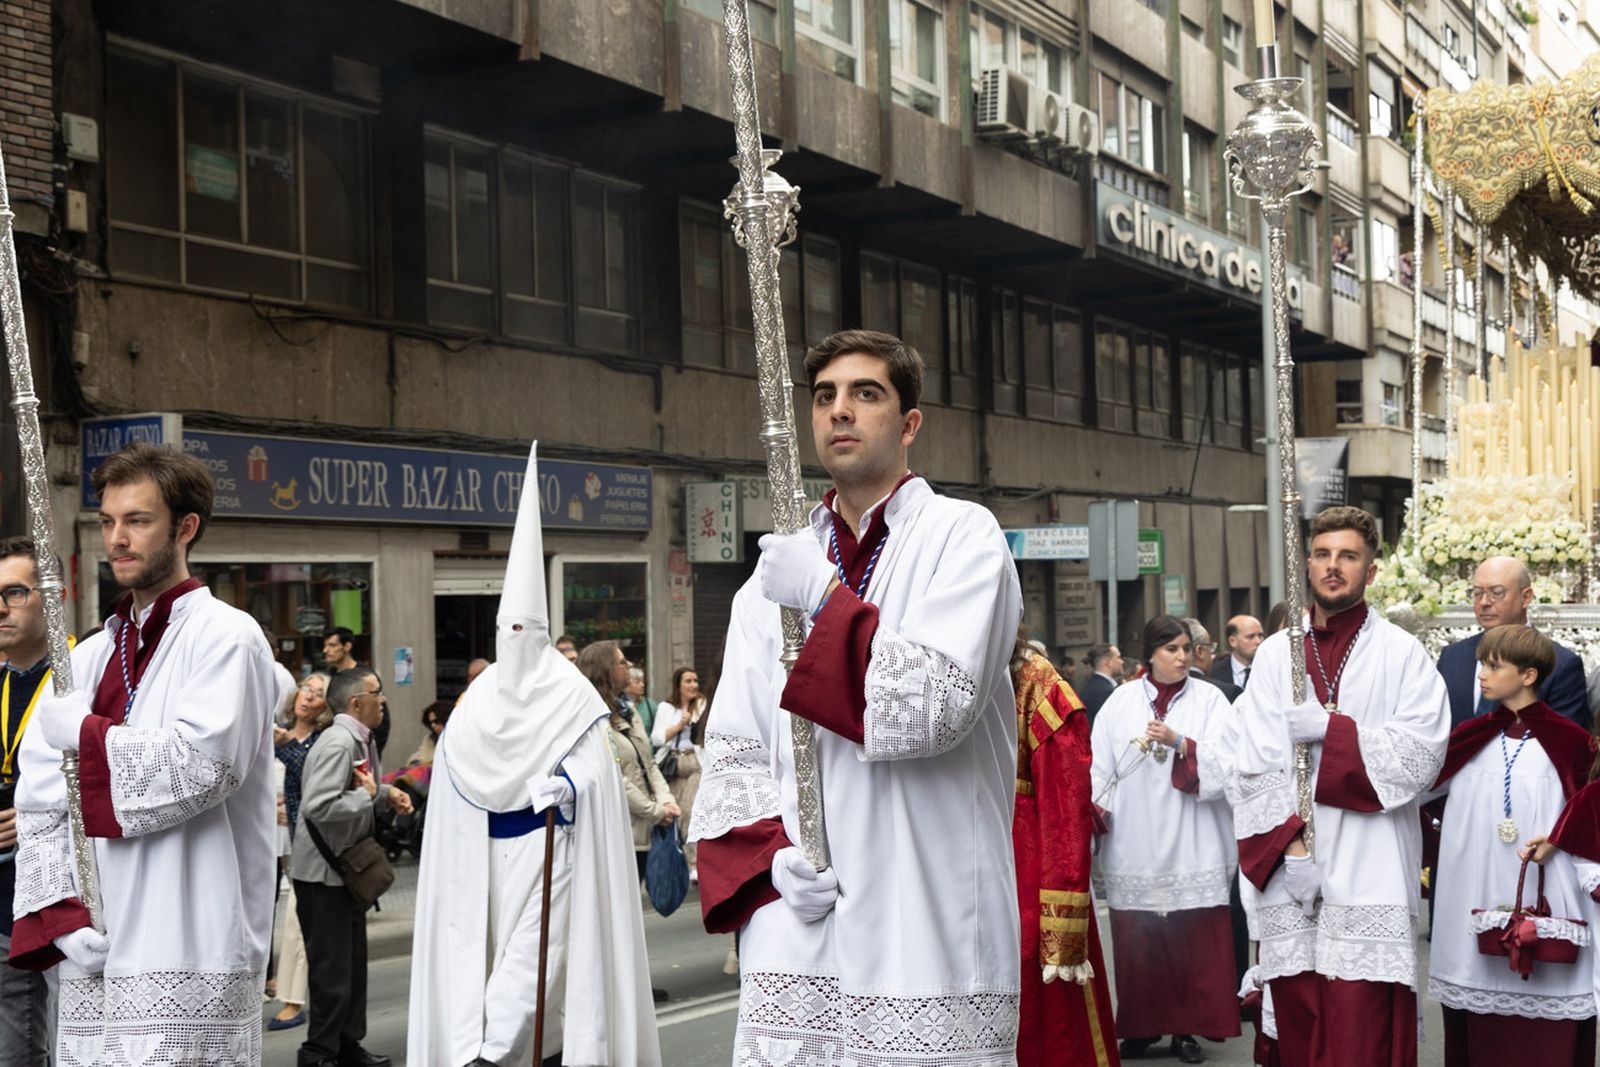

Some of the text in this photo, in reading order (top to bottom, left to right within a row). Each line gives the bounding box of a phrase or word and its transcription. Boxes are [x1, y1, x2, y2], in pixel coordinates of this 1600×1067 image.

[1226, 246, 1262, 294] de
[87, 427, 121, 457] BAZAR
[183, 439, 209, 453] OPA
[308, 457, 561, 515] SUPER BAZAR CHNO
[615, 473, 648, 485] MENAJE
[606, 487, 648, 498] JUGUETES
[720, 484, 733, 560] CHINO
[1027, 529, 1088, 537] MERCEDES
